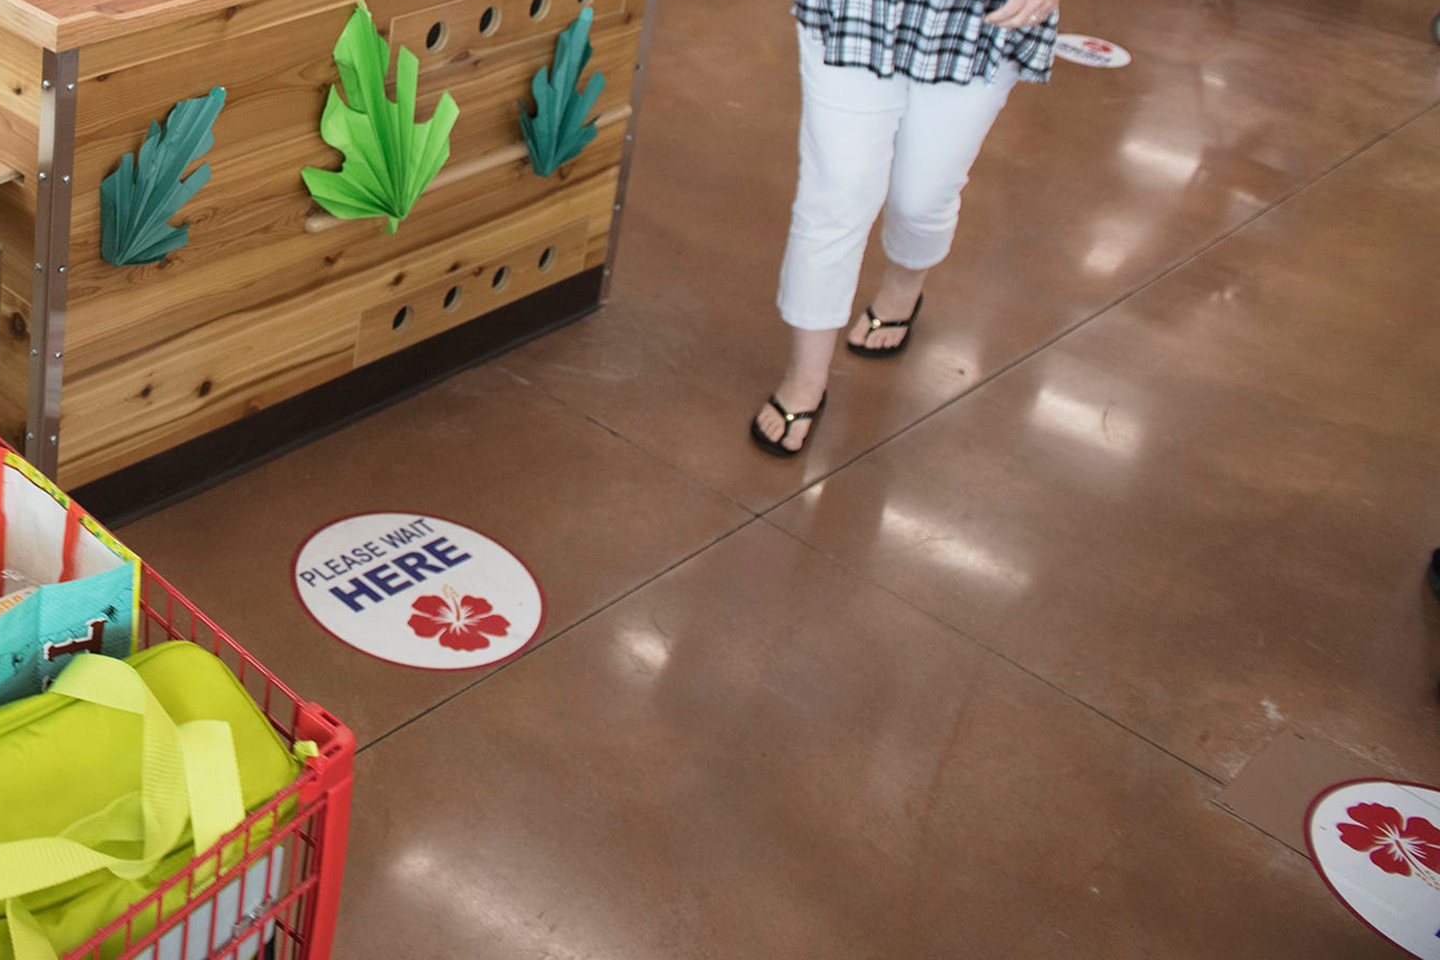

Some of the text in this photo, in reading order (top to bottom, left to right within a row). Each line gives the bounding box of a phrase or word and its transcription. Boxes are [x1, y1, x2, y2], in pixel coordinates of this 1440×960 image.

[299, 518, 436, 588] PLEASE WAIT
[328, 536, 473, 613] HERE
